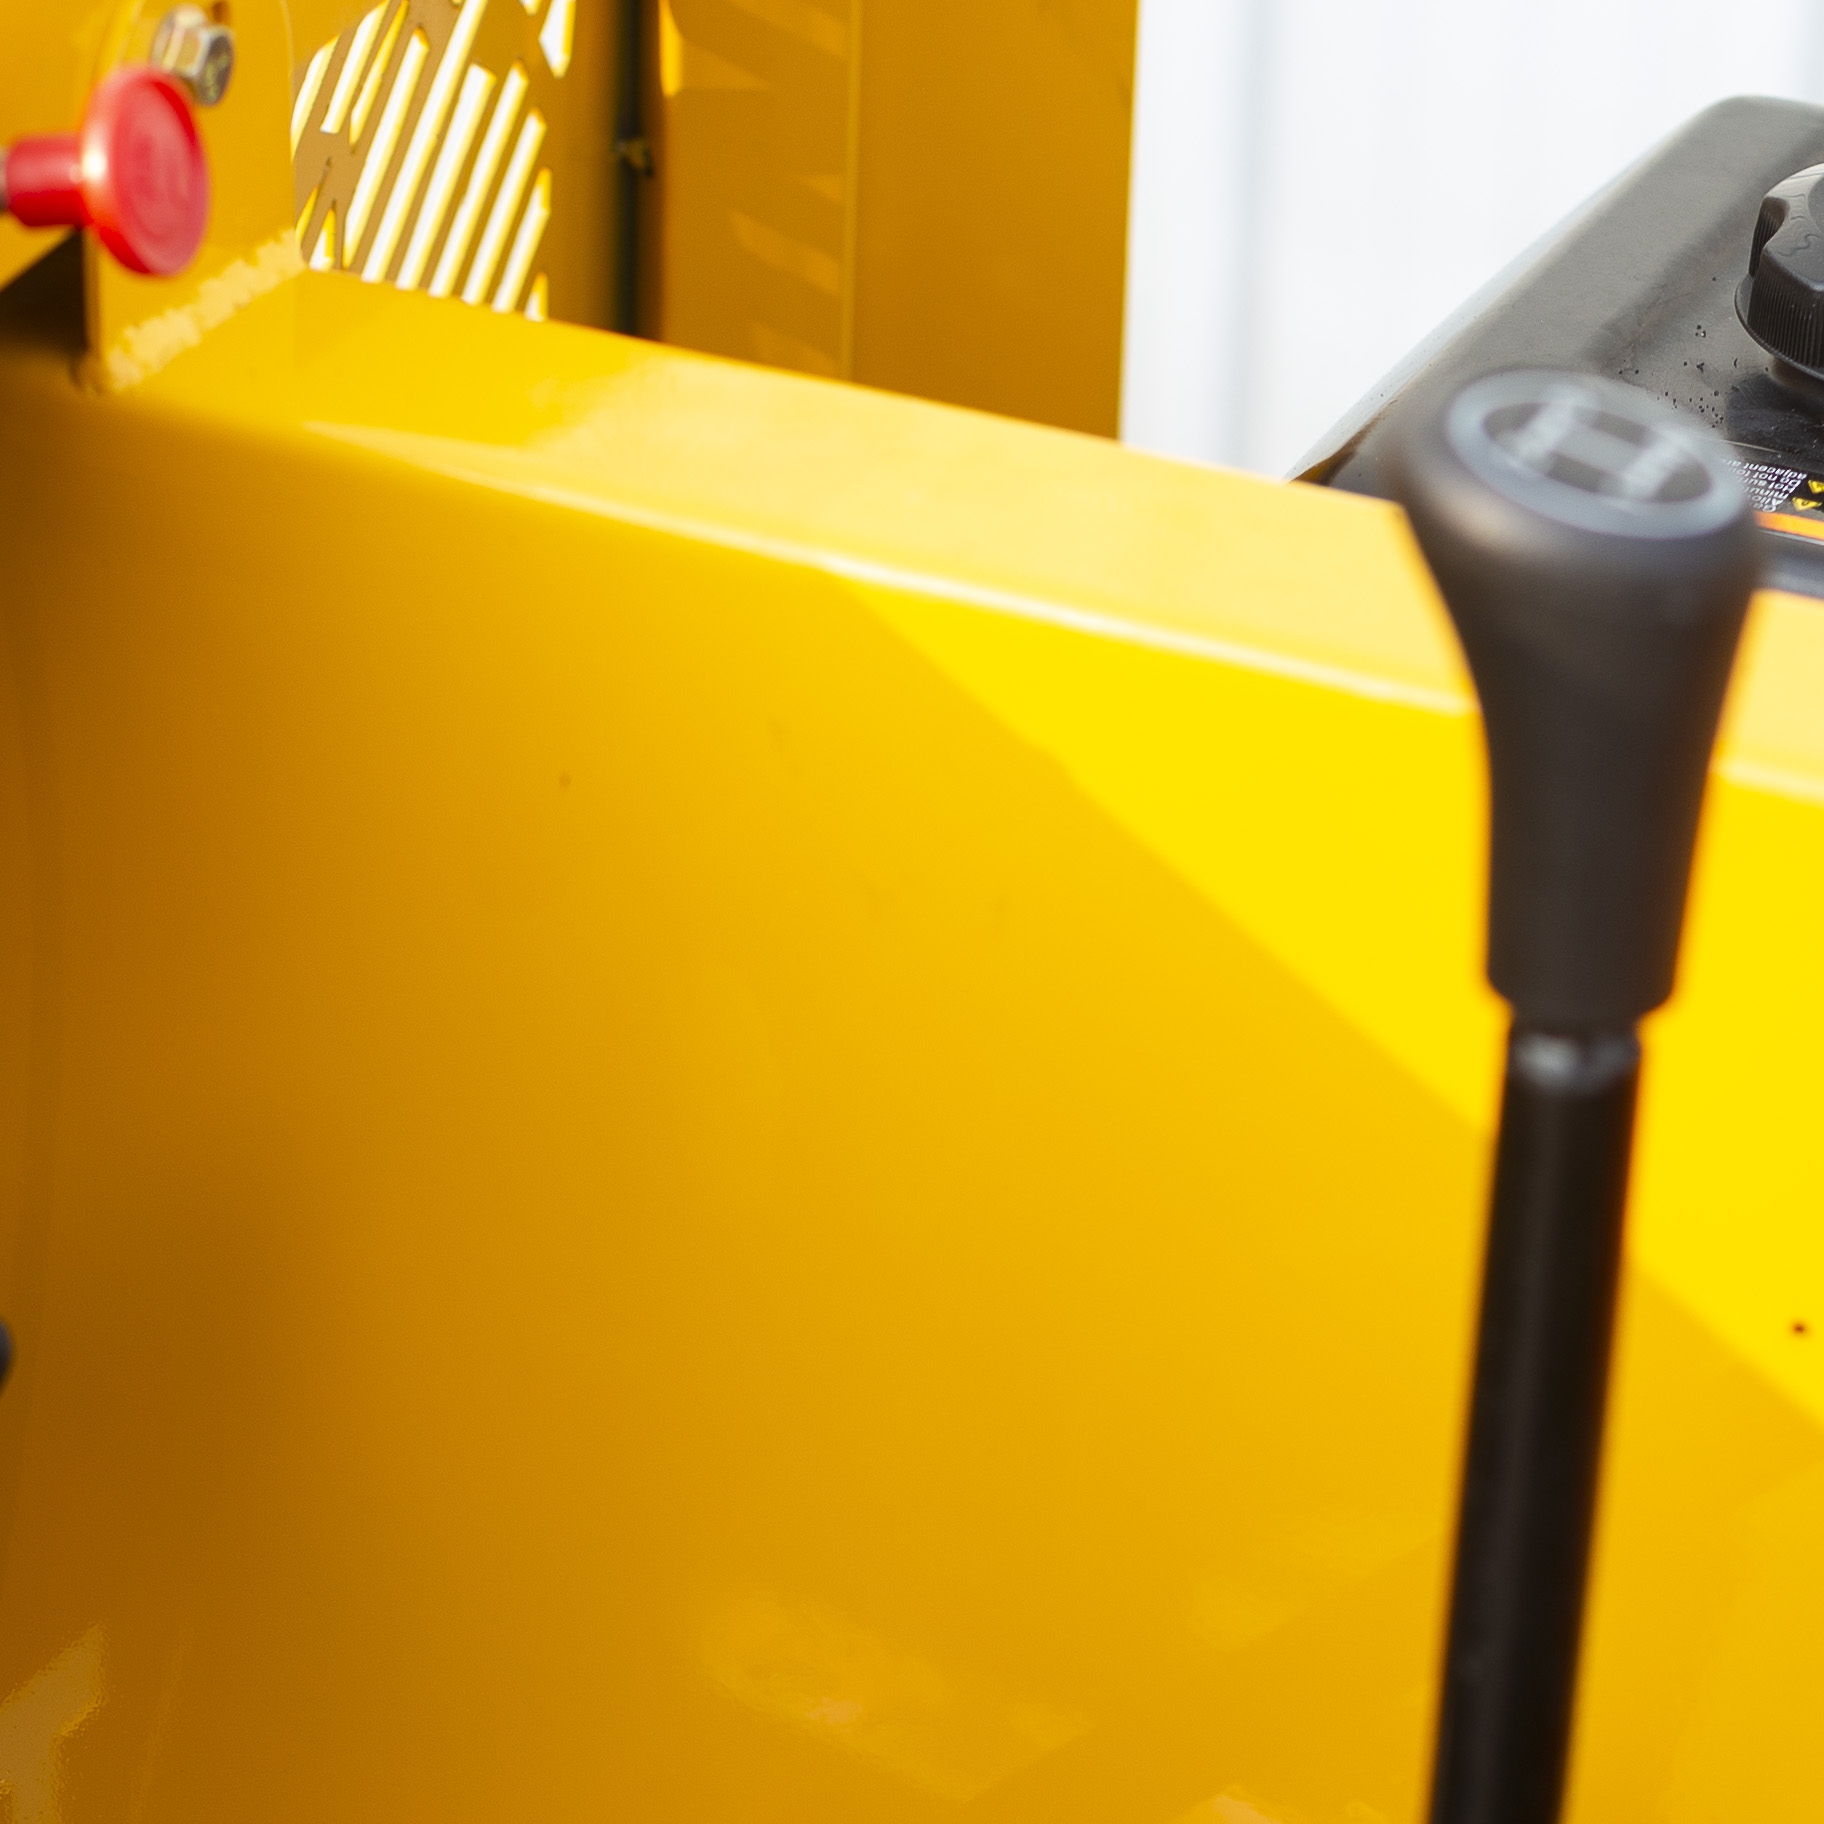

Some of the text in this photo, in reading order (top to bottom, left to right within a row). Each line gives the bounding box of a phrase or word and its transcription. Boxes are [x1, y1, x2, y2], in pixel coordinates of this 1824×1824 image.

[1743, 462, 1808, 480] adjacent
[1751, 470, 1778, 482] not
[1767, 483, 1796, 493] Hot
